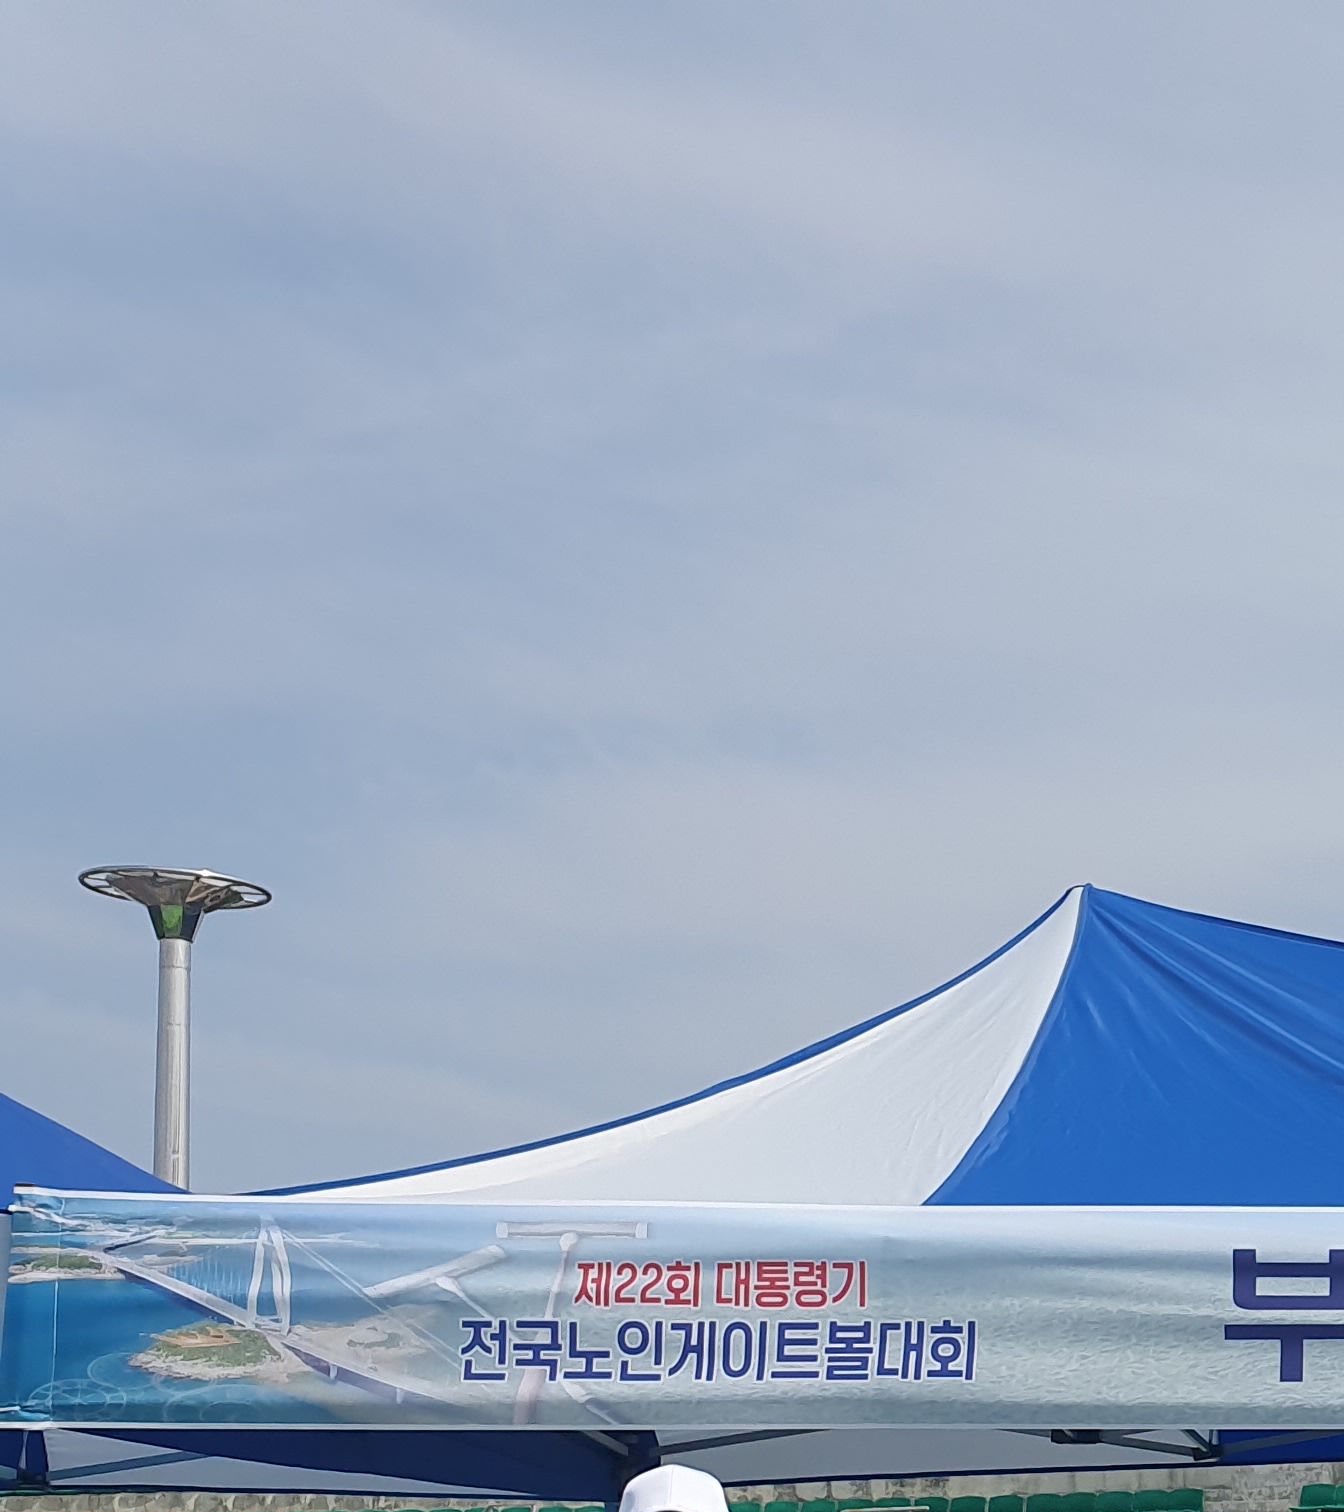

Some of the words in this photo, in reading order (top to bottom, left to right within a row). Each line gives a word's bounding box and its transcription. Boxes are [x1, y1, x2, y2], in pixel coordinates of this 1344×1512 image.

[574, 1261, 701, 1307] 제22회
[715, 1260, 867, 1308] 대통령기
[459, 1318, 977, 1382] 전국노인게이트볼대회
